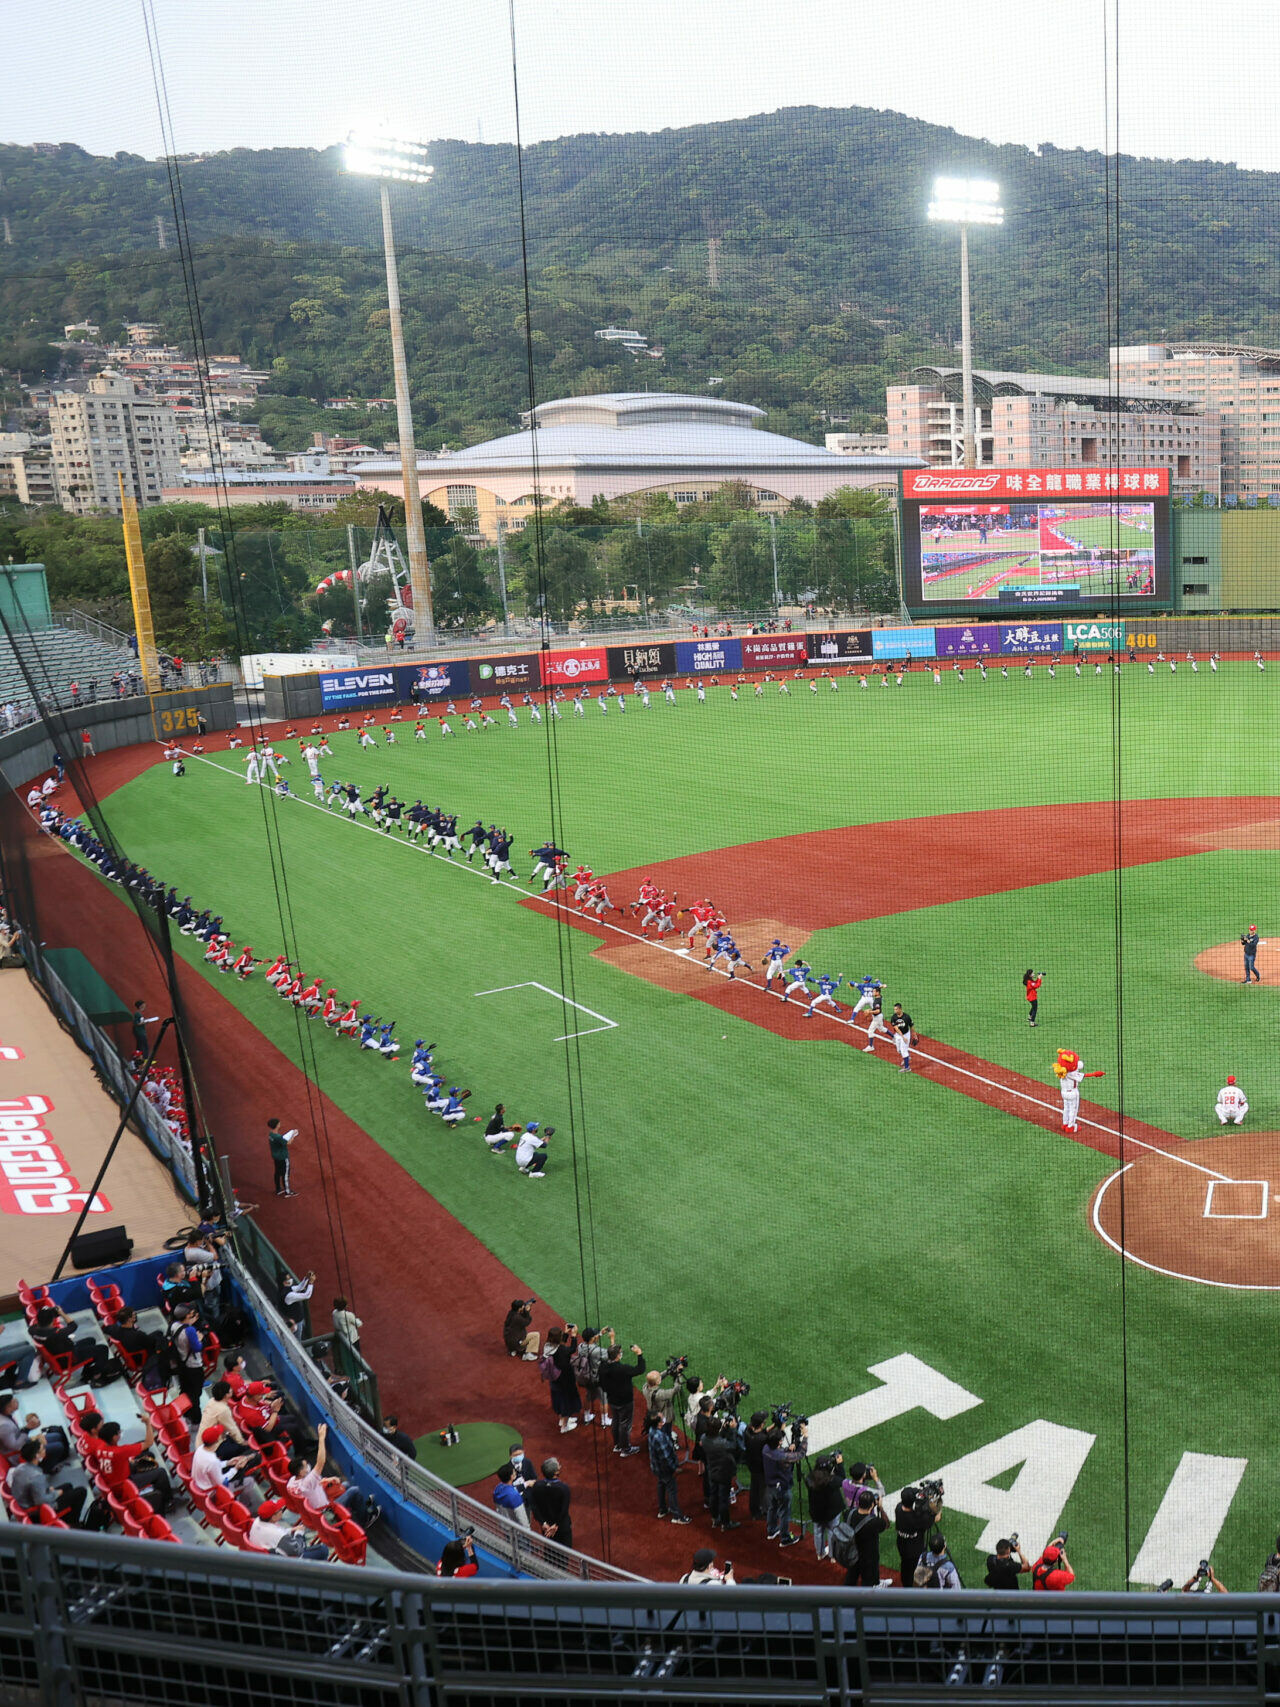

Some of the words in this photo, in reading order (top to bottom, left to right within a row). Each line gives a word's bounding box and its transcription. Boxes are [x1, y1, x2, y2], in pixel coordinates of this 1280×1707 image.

[912, 474, 1000, 491] DRAGONS
[1006, 473, 1160, 491] 味全龍職業棒球隊
[1126, 633, 1157, 648] 400
[494, 663, 529, 678] 德克士
[694, 659, 725, 670] QUALITY
[322, 672, 395, 693] ELEVEN
[161, 707, 198, 731] 325
[1224, 1095, 1235, 1105] 28
